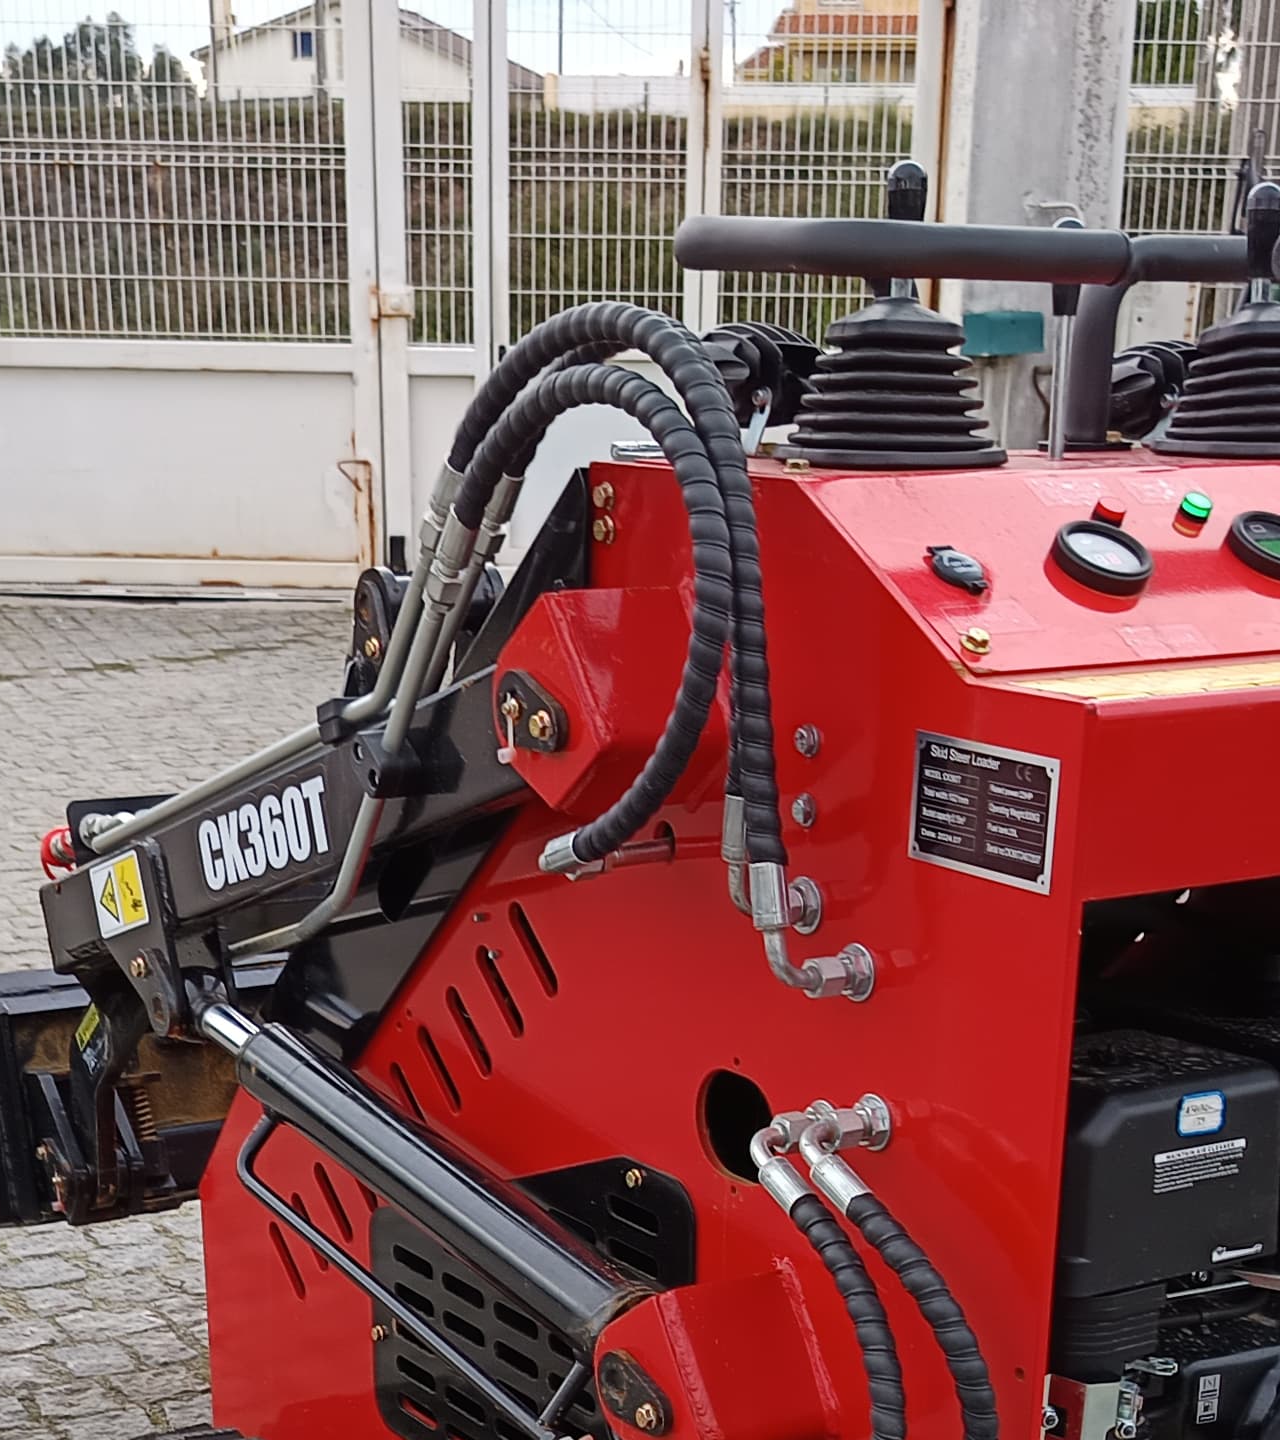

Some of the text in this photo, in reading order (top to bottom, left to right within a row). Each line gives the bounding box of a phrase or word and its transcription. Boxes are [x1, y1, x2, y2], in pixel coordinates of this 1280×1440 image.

[930, 744, 948, 760] Skid
[971, 753, 1001, 771] Loader
[198, 775, 330, 892] CK360T
